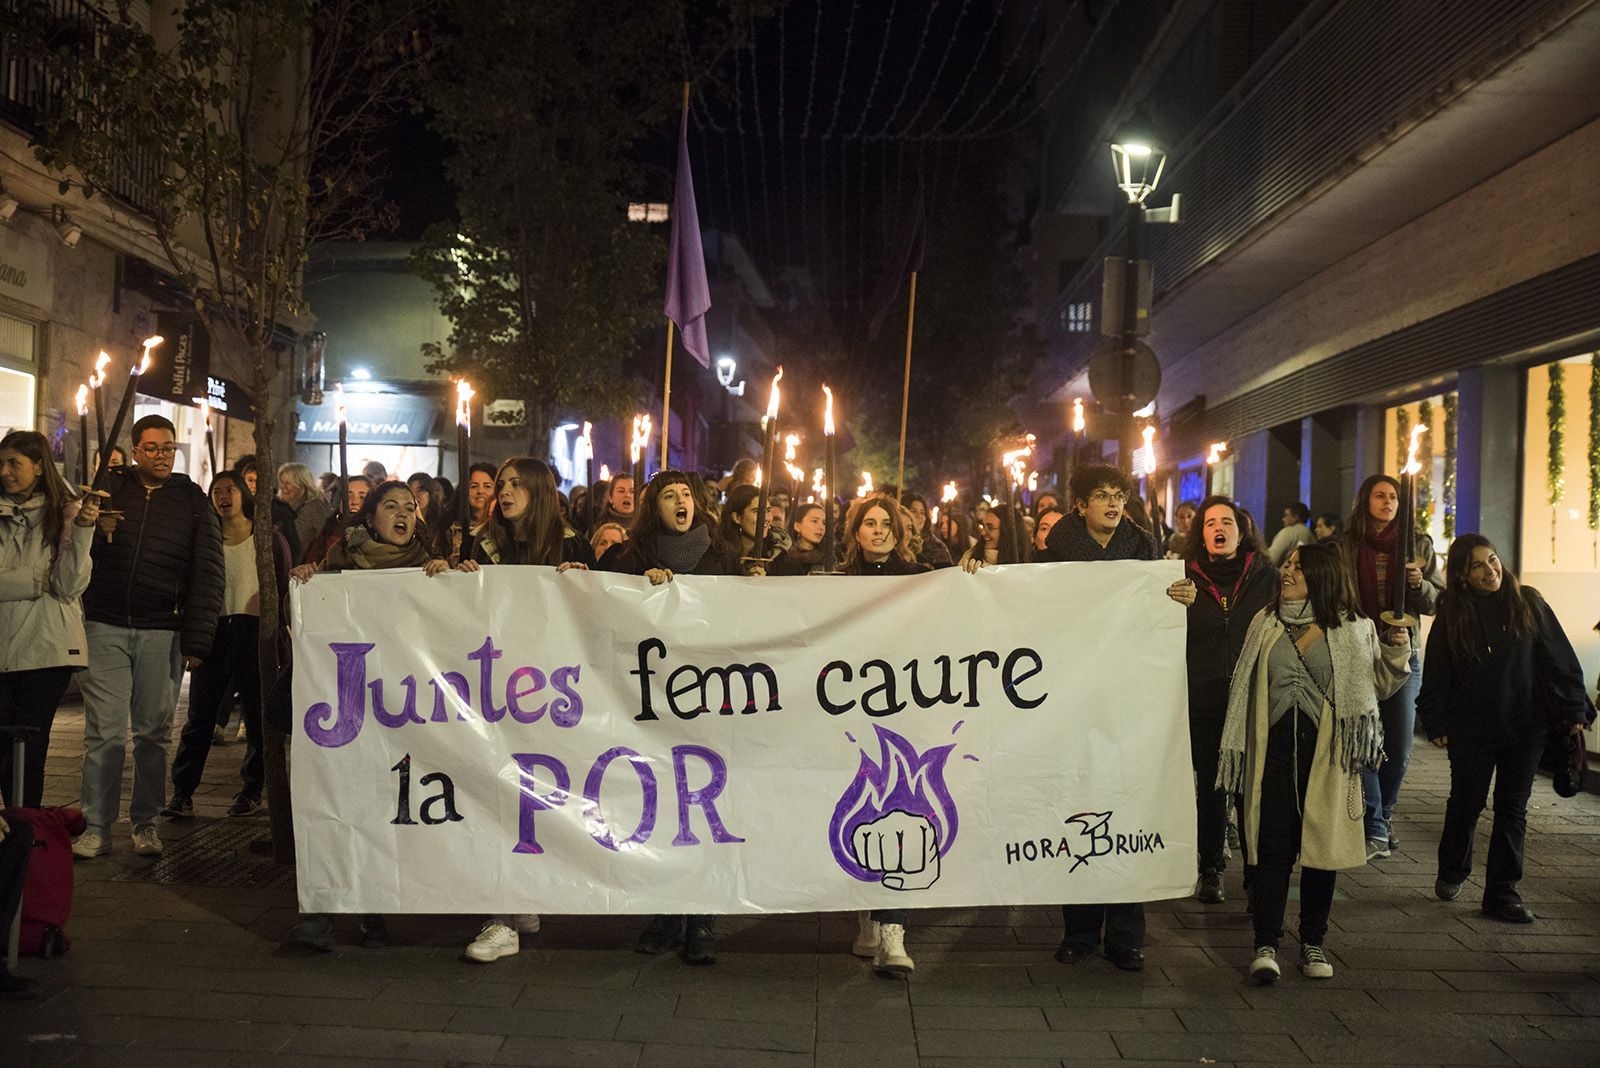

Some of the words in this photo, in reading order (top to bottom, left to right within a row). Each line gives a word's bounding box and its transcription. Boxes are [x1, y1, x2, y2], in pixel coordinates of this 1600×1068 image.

[303, 636, 584, 748] Juntes
[630, 637, 782, 721] fem
[816, 647, 1048, 718] caure
[390, 752, 464, 826] la
[510, 744, 746, 855] POR
[1006, 836, 1072, 865] HORA
